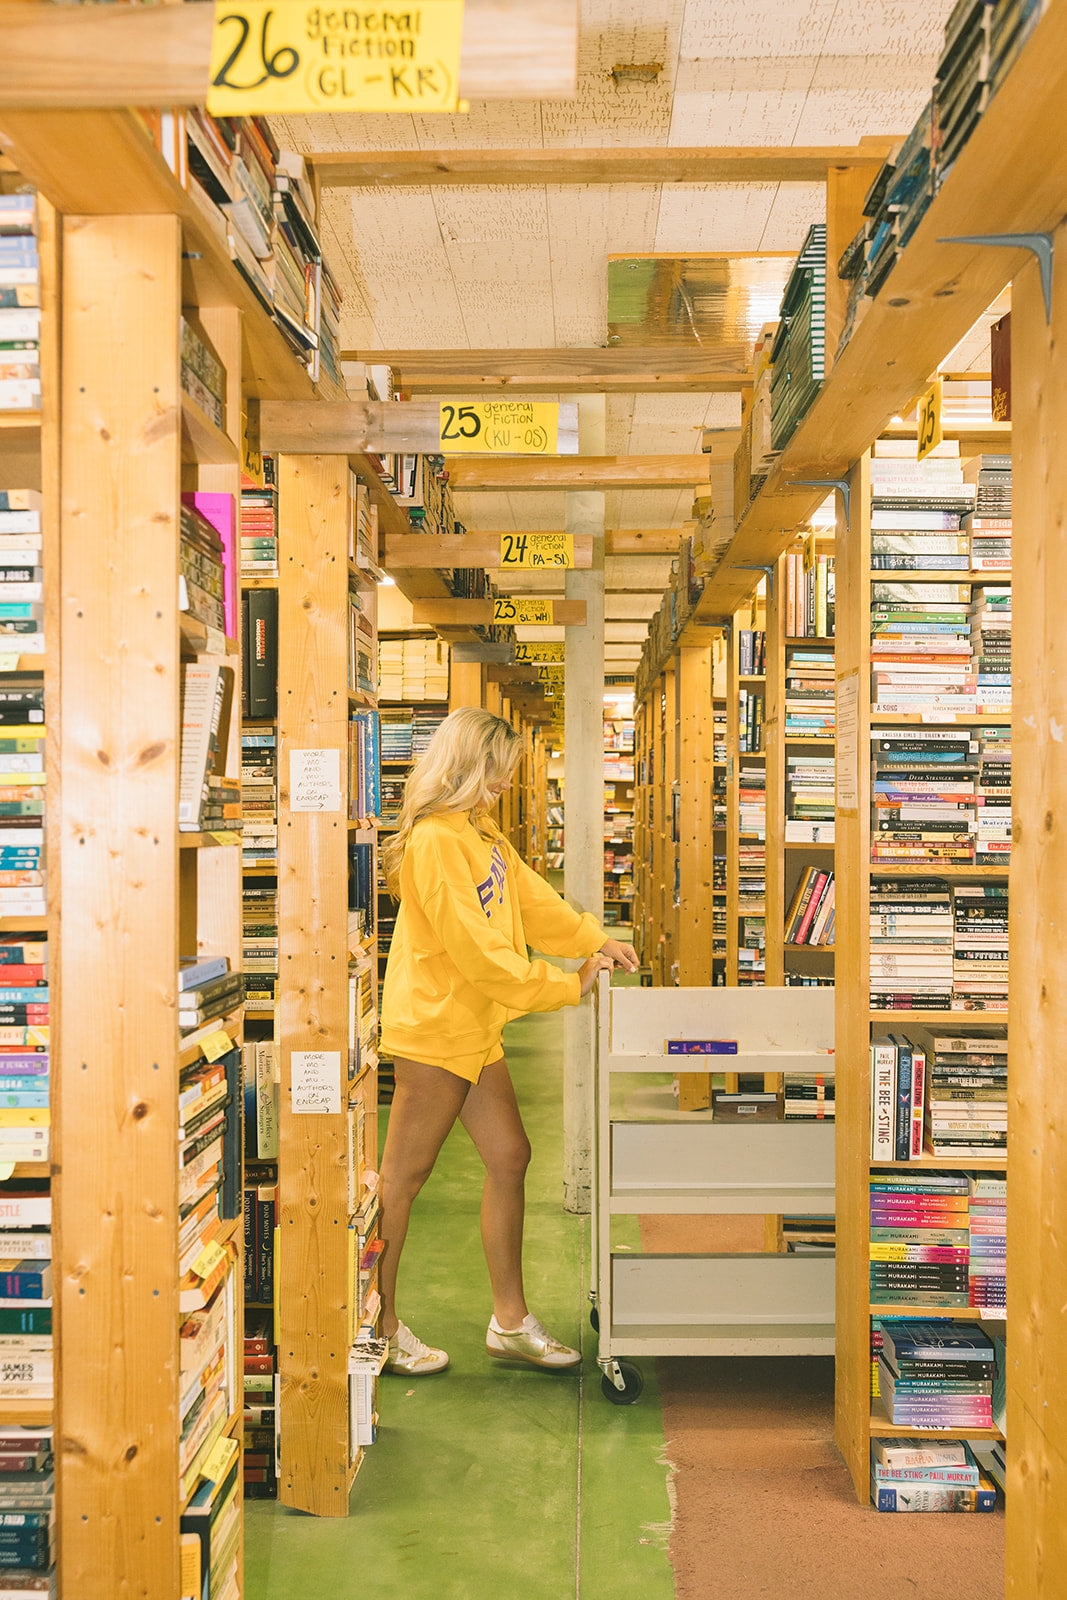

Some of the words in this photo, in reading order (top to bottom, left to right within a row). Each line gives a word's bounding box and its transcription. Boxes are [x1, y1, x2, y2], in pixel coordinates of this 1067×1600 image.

[306, 8, 422, 39] general
[213, 10, 300, 89] 26
[484, 402, 534, 418] general
[442, 406, 481, 440] 25
[530, 534, 567, 546] general
[503, 535, 528, 562] 24
[495, 600, 516, 620] 23
[516, 645, 532, 660] 22
[538, 666, 550, 679] 21
[879, 1070, 890, 1086] THE
[296, 1098, 331, 1106] ENDCAP
[879, 1091, 890, 1106] BEE
[878, 1115, 890, 1144] STING
[2, 1364, 33, 1372] JAMES
[3, 1373, 33, 1381] JONES
[878, 1469, 889, 1478] THE
[929, 1472, 944, 1480] PAUL
[947, 1473, 971, 1482] MURRAY
